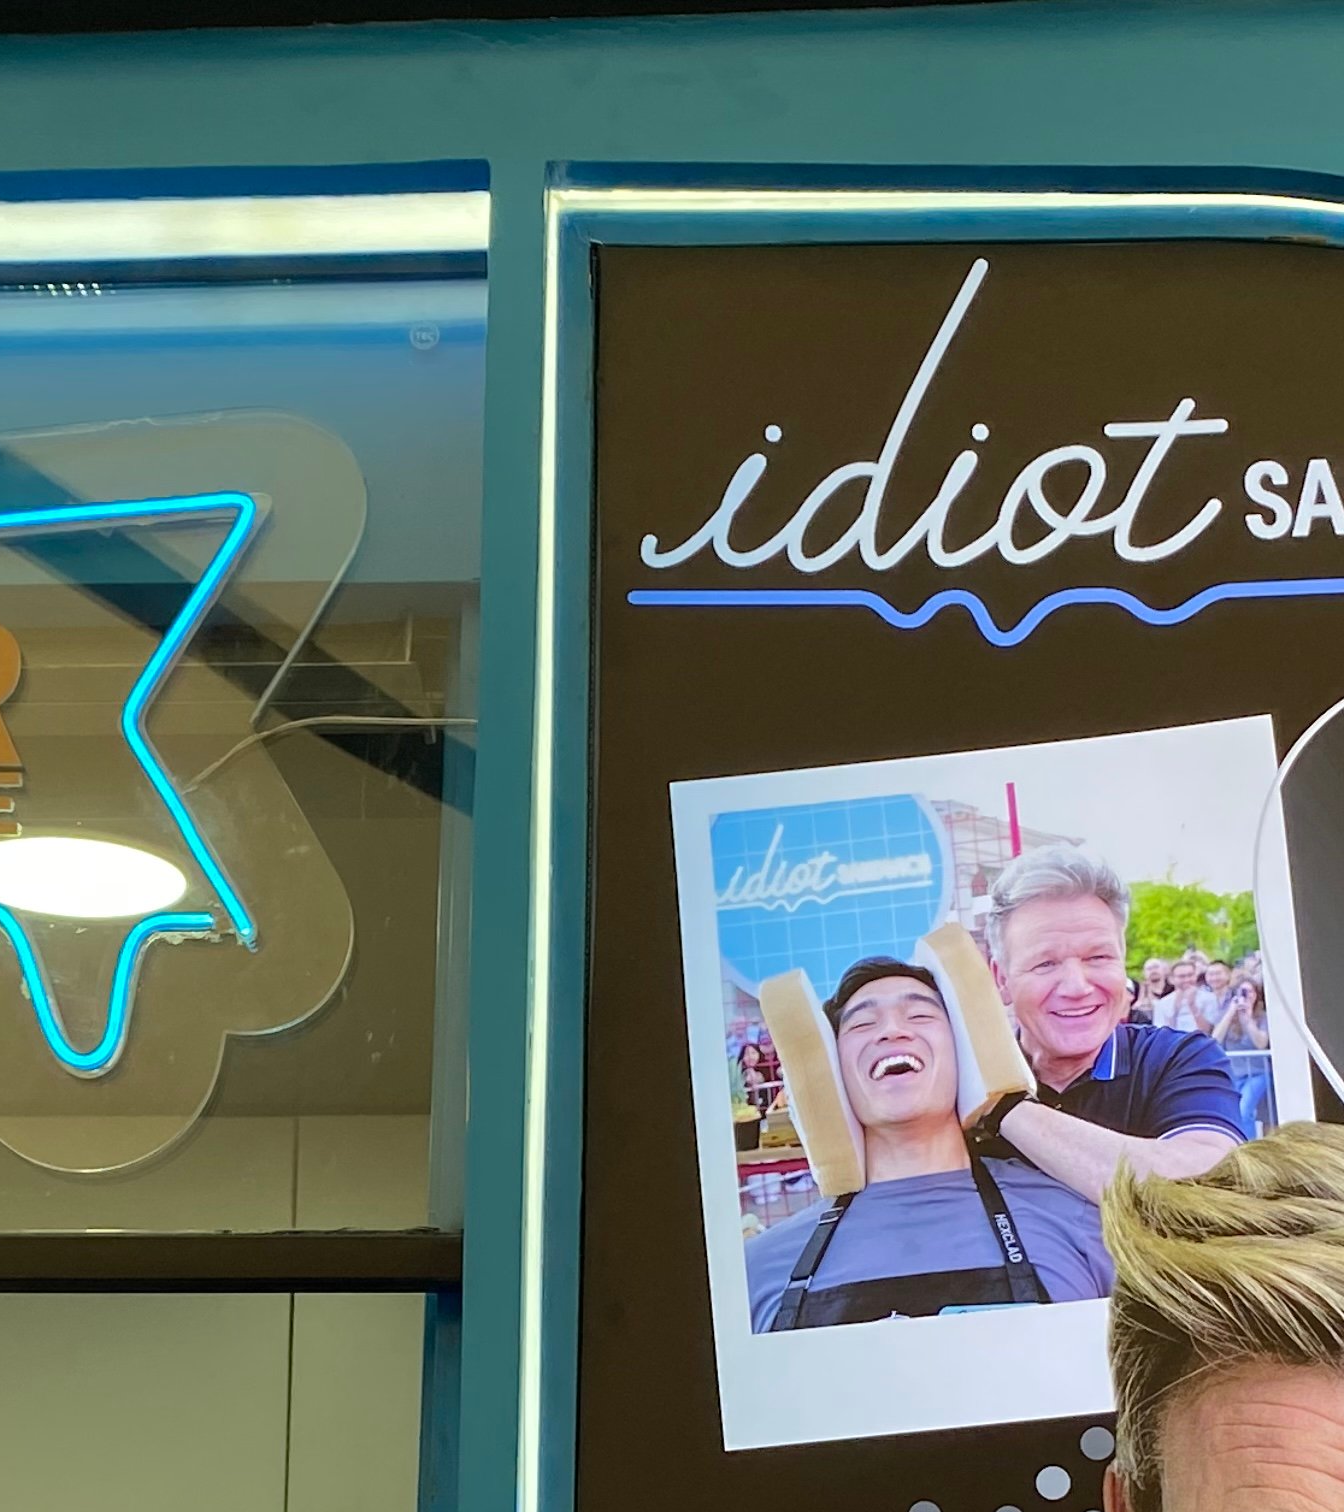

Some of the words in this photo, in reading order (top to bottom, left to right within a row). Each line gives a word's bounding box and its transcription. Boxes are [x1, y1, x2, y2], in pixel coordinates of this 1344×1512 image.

[640, 257, 1230, 574] idiot
[716, 823, 838, 904] idiot
[994, 1213, 1024, 1264] HEXCLAD
